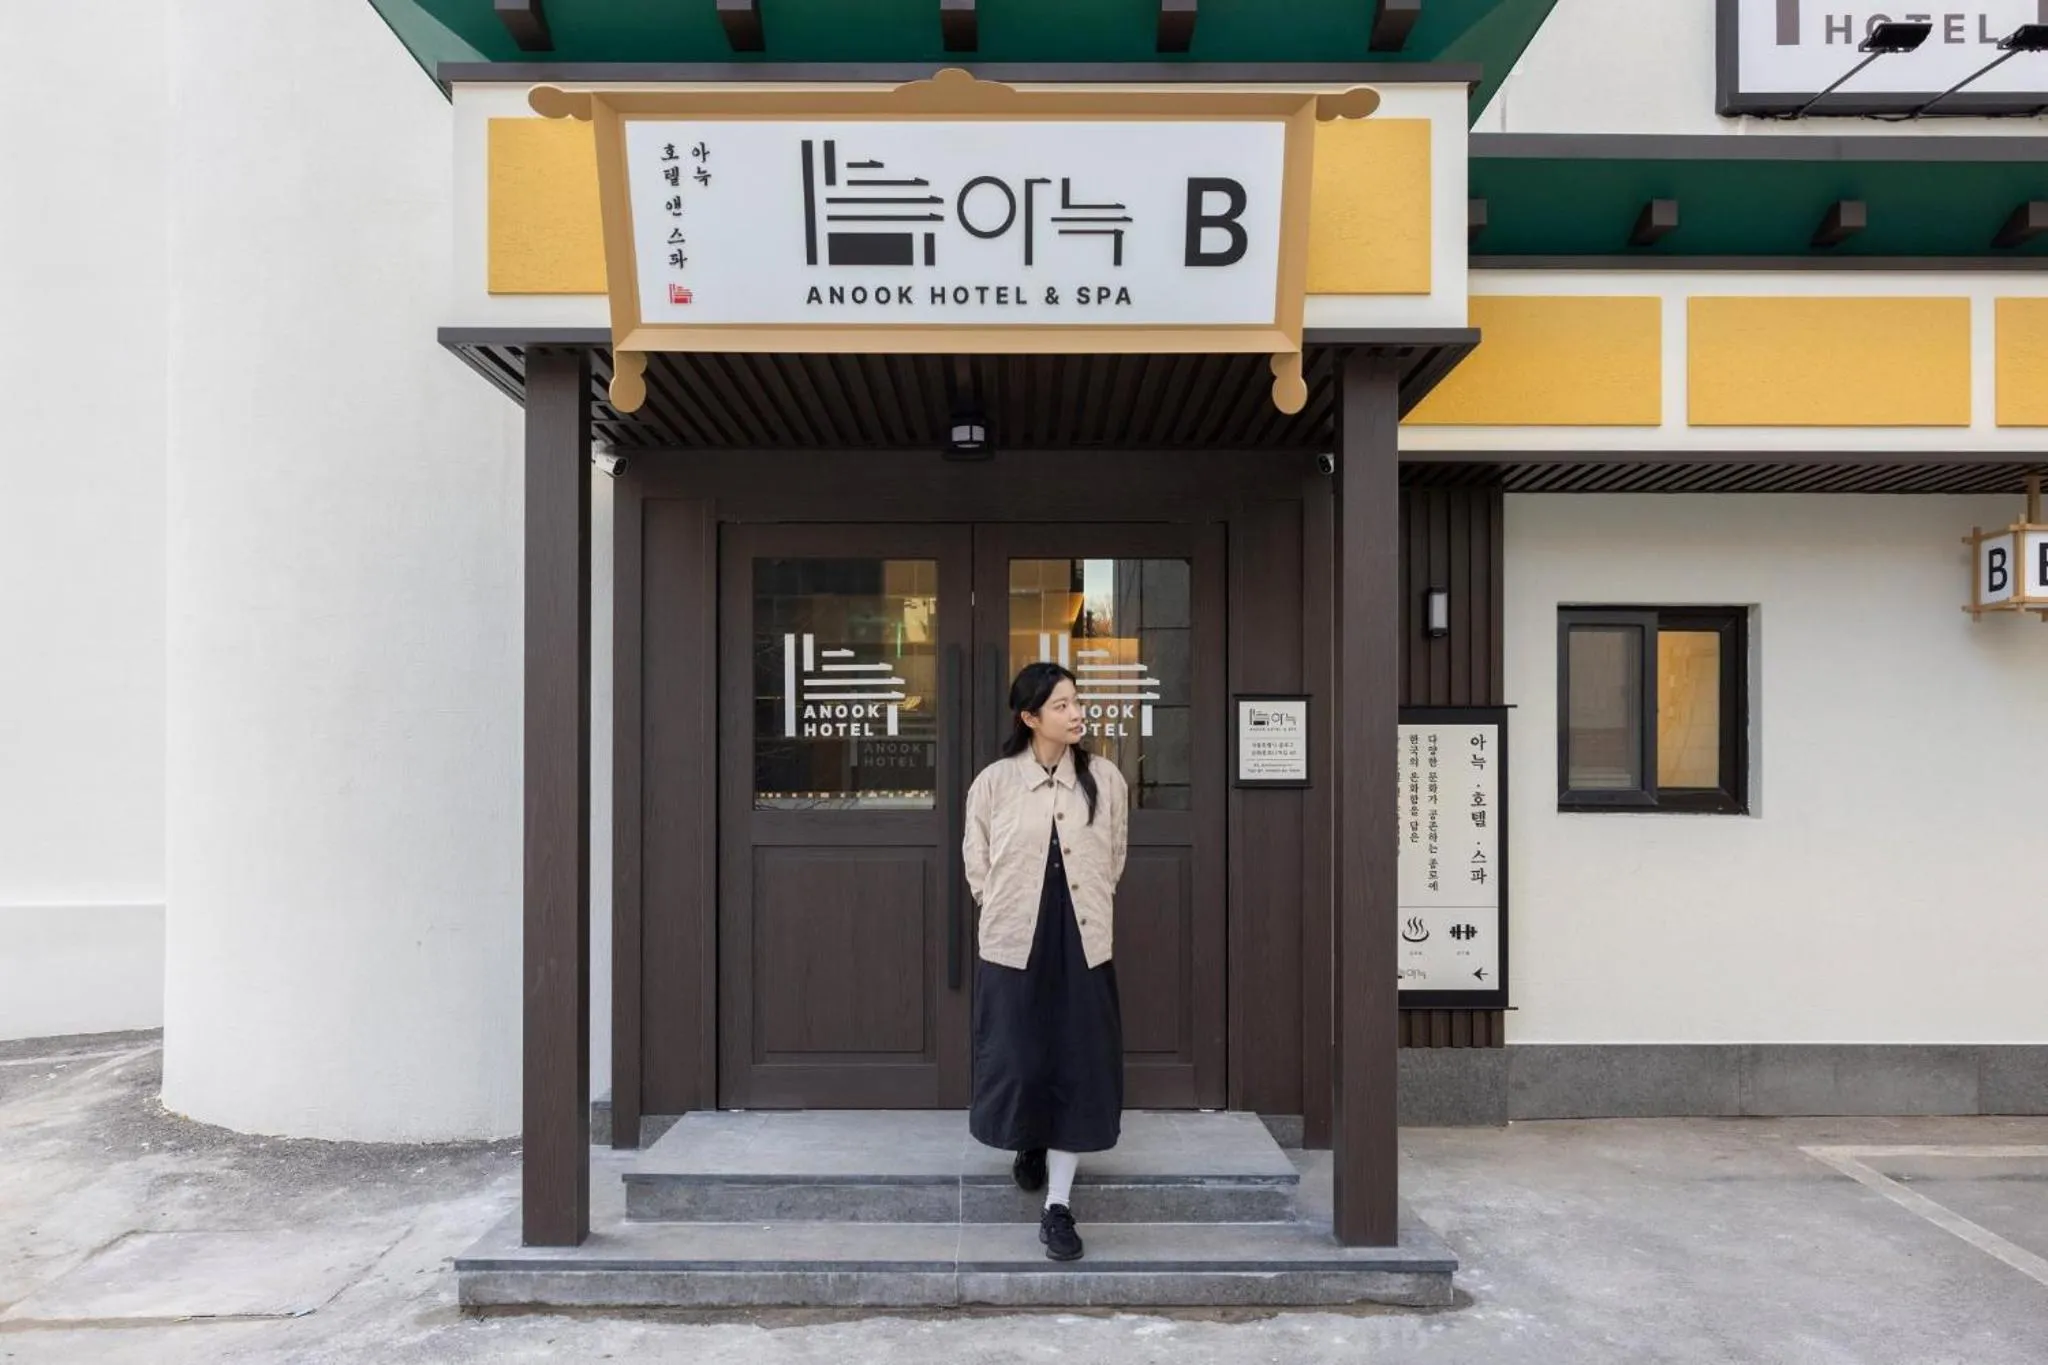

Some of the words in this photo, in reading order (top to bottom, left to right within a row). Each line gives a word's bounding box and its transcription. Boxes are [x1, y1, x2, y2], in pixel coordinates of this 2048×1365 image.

[1825, 14, 1999, 44] HEL
[661, 143, 680, 187] 호텔
[665, 195, 682, 216] 앤
[1184, 177, 1248, 267] B
[667, 228, 688, 269] 스파
[806, 286, 914, 305] ANOOK
[930, 286, 1027, 305] HOTEL
[1044, 286, 1060, 305] &
[1076, 286, 1133, 305] SPA
[1988, 547, 2008, 593] B
[803, 704, 880, 719] ANOOK
[803, 723, 874, 737] HOTEL
[1080, 723, 1128, 737] OTEL
[863, 743, 921, 754] ANOOK
[1470, 733, 1488, 771] 아늑
[863, 756, 916, 767] HOTEL
